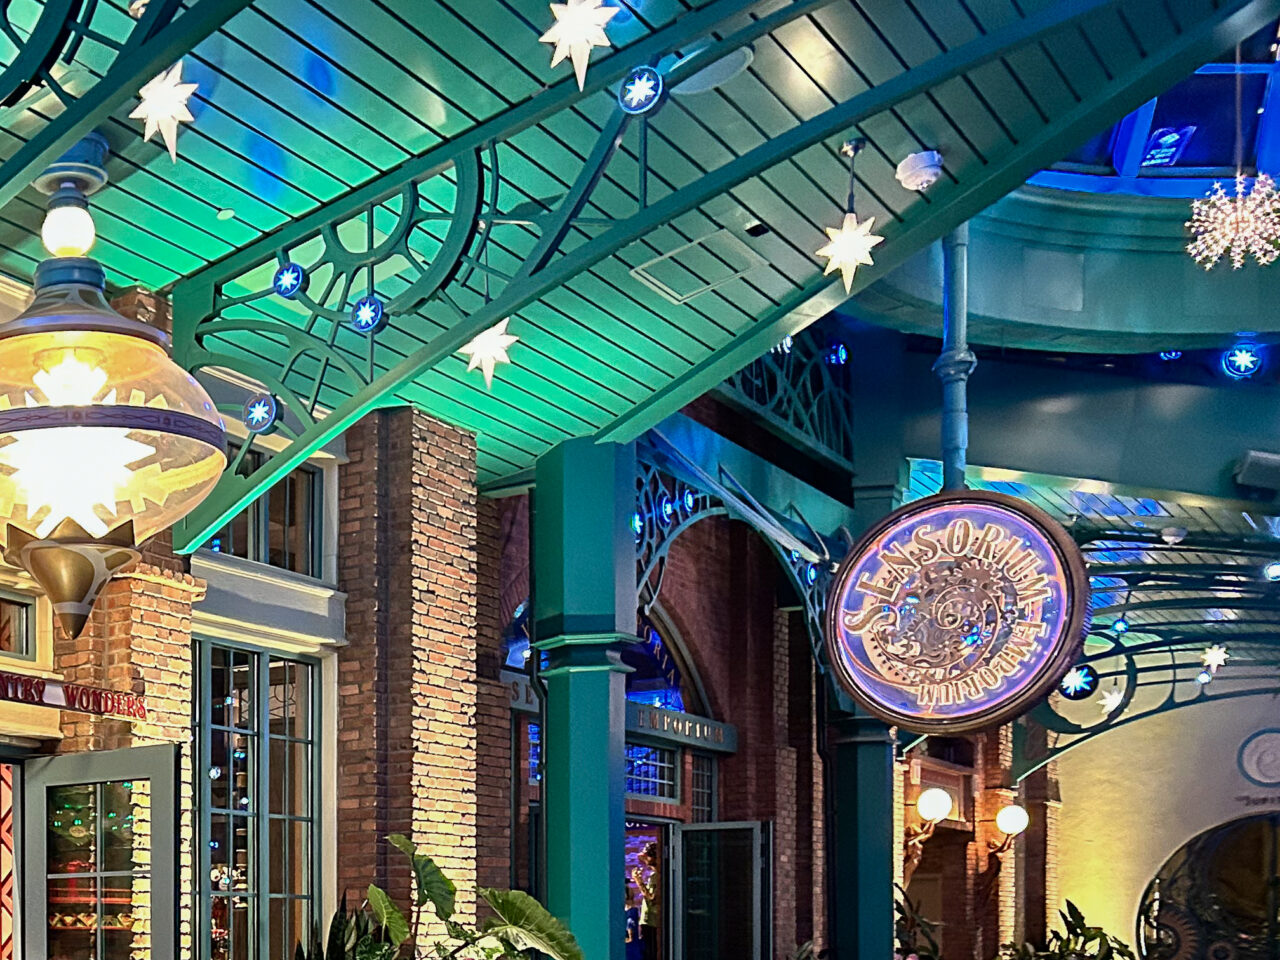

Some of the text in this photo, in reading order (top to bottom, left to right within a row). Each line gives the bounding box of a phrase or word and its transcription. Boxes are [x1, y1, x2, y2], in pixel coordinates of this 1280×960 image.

[843, 518, 1052, 706] SENSORIUM EMPORIUM
[62, 683, 147, 720] WONDERS
[637, 708, 725, 744] EMPORIUM
